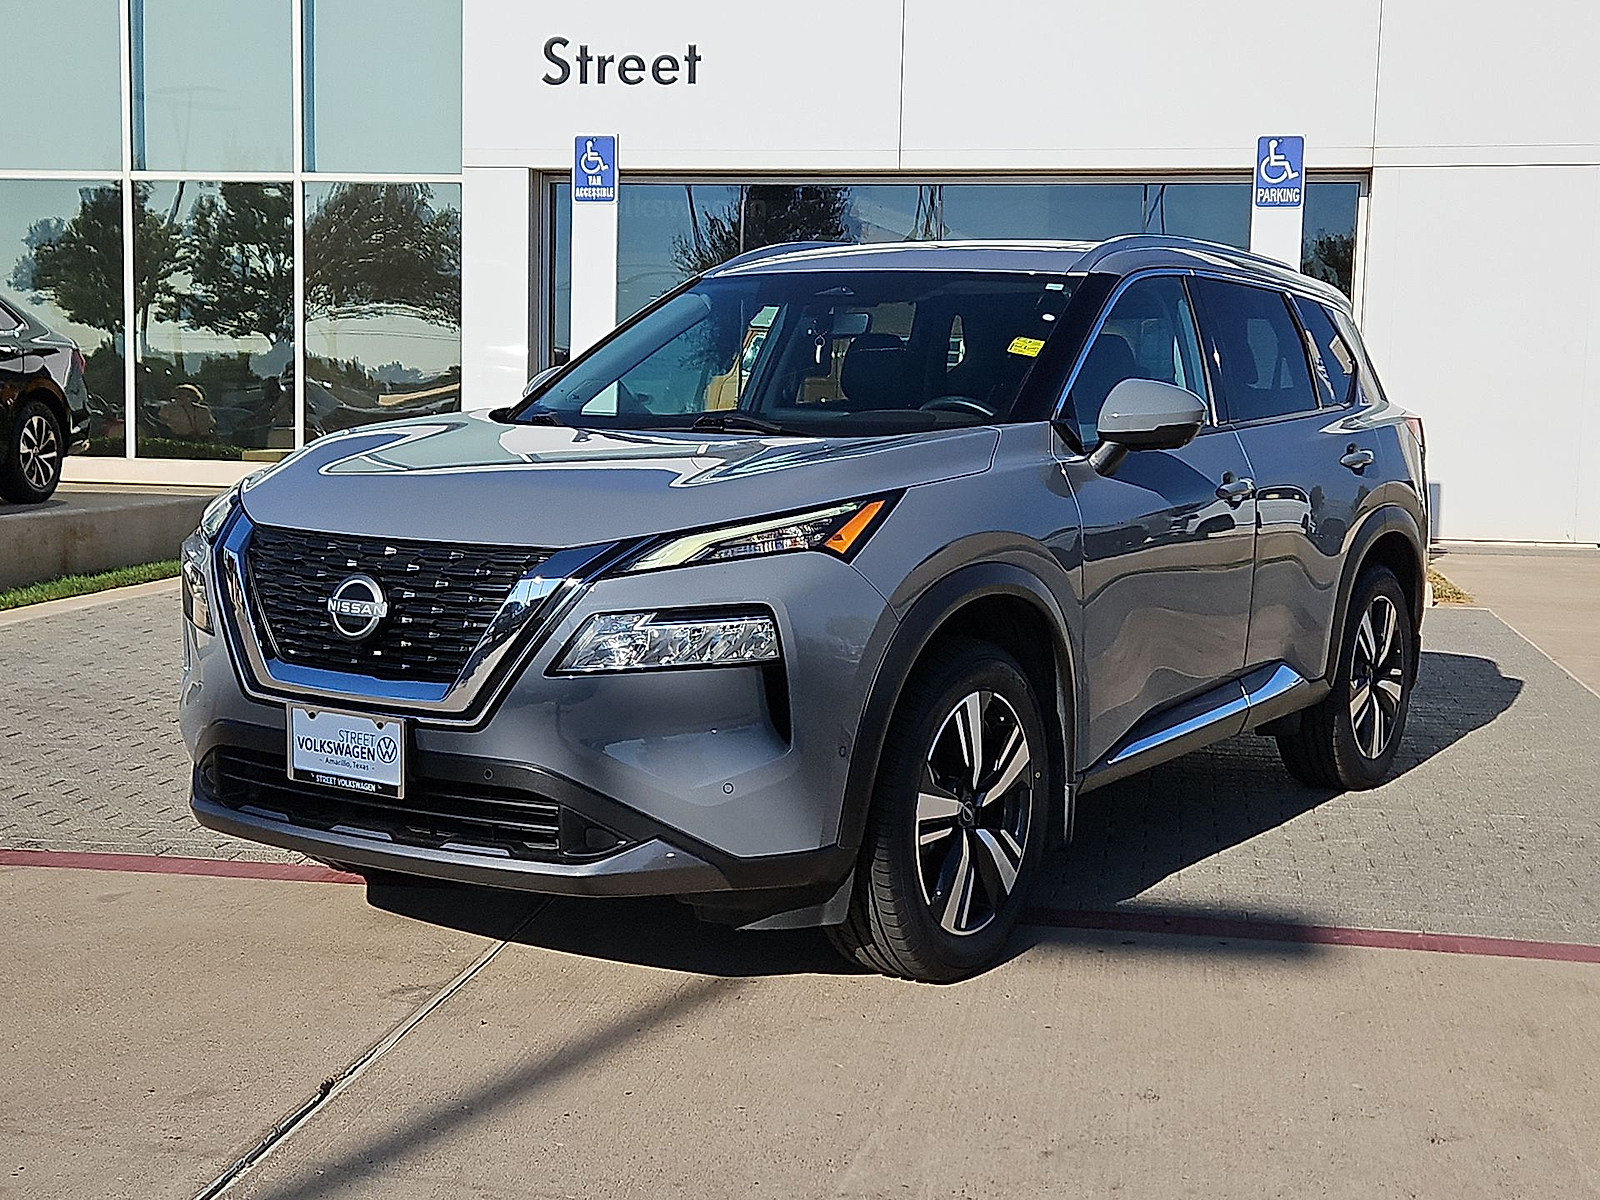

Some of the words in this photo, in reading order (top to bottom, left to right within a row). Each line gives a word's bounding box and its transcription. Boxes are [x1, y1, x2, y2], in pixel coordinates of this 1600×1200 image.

[541, 36, 702, 85] Street
[575, 186, 614, 198] ACCESSIBLE
[1257, 187, 1300, 203] PARKING
[327, 598, 386, 616] NISSAN
[338, 729, 376, 747] STREET
[296, 735, 376, 761] VOLKSWAGEN
[316, 774, 337, 786] STREET
[337, 778, 376, 792] VOLKSWAGEN
